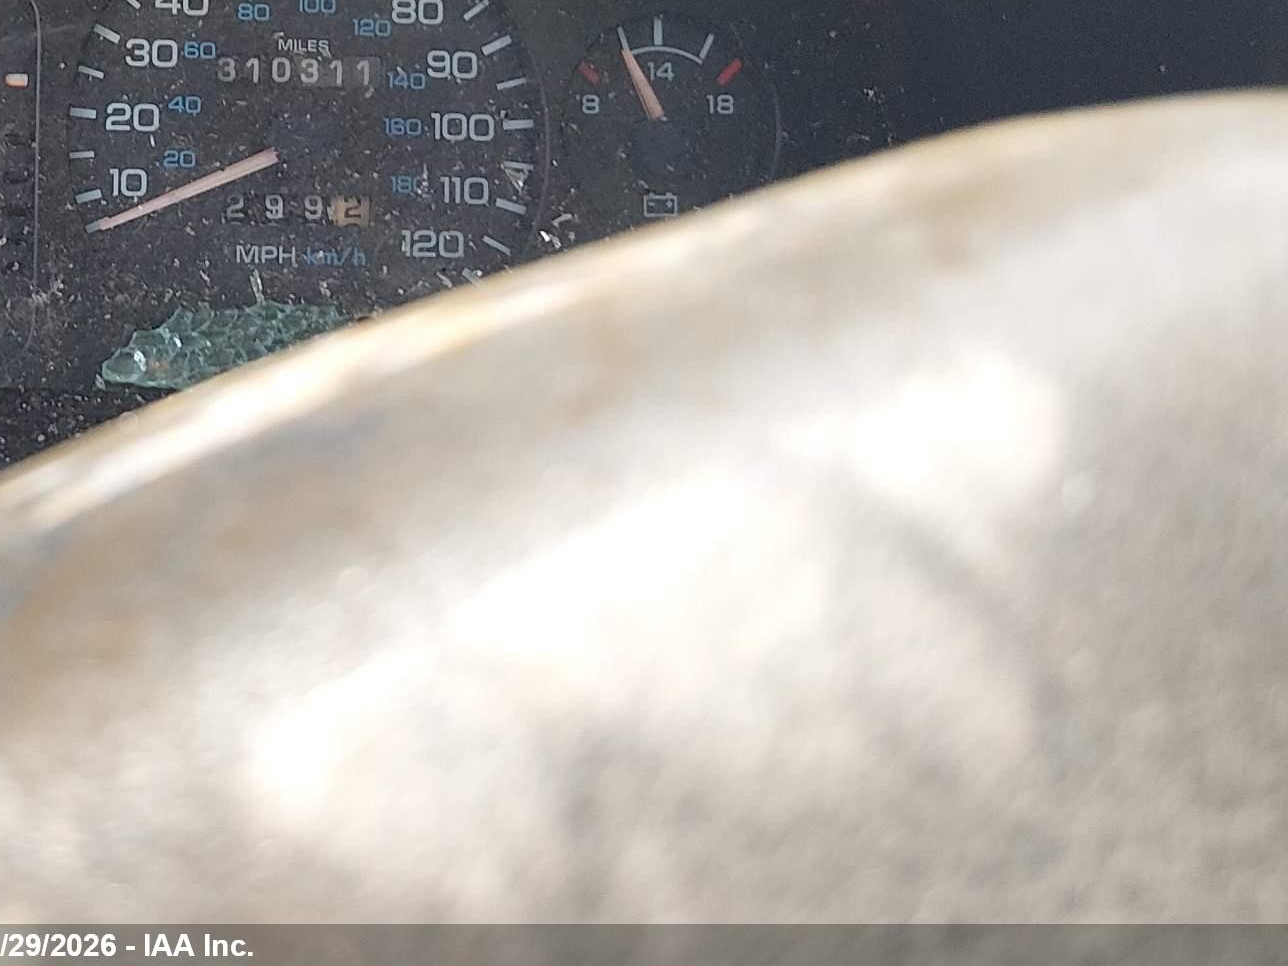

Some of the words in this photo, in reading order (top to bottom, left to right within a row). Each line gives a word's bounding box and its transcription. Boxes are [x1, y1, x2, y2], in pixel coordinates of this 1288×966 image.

[237, 3, 270, 22] 80
[353, 18, 391, 36] 120
[125, 38, 178, 67] 30
[184, 41, 216, 59] 60
[278, 38, 330, 52] MILES
[217, 56, 372, 85] 310311
[426, 50, 478, 79] 90
[646, 62, 674, 81] 14
[387, 71, 426, 90] 140
[167, 95, 202, 114] 40
[581, 95, 600, 115] 8
[707, 94, 734, 115] 18
[105, 103, 160, 132] 20
[383, 117, 422, 136] 160
[431, 112, 494, 142] 100
[163, 150, 196, 168] 20
[110, 169, 147, 197] 10
[440, 176, 489, 205] 110
[401, 229, 465, 258] 120
[235, 244, 296, 265] MPH
[305, 247, 367, 266] km/h
